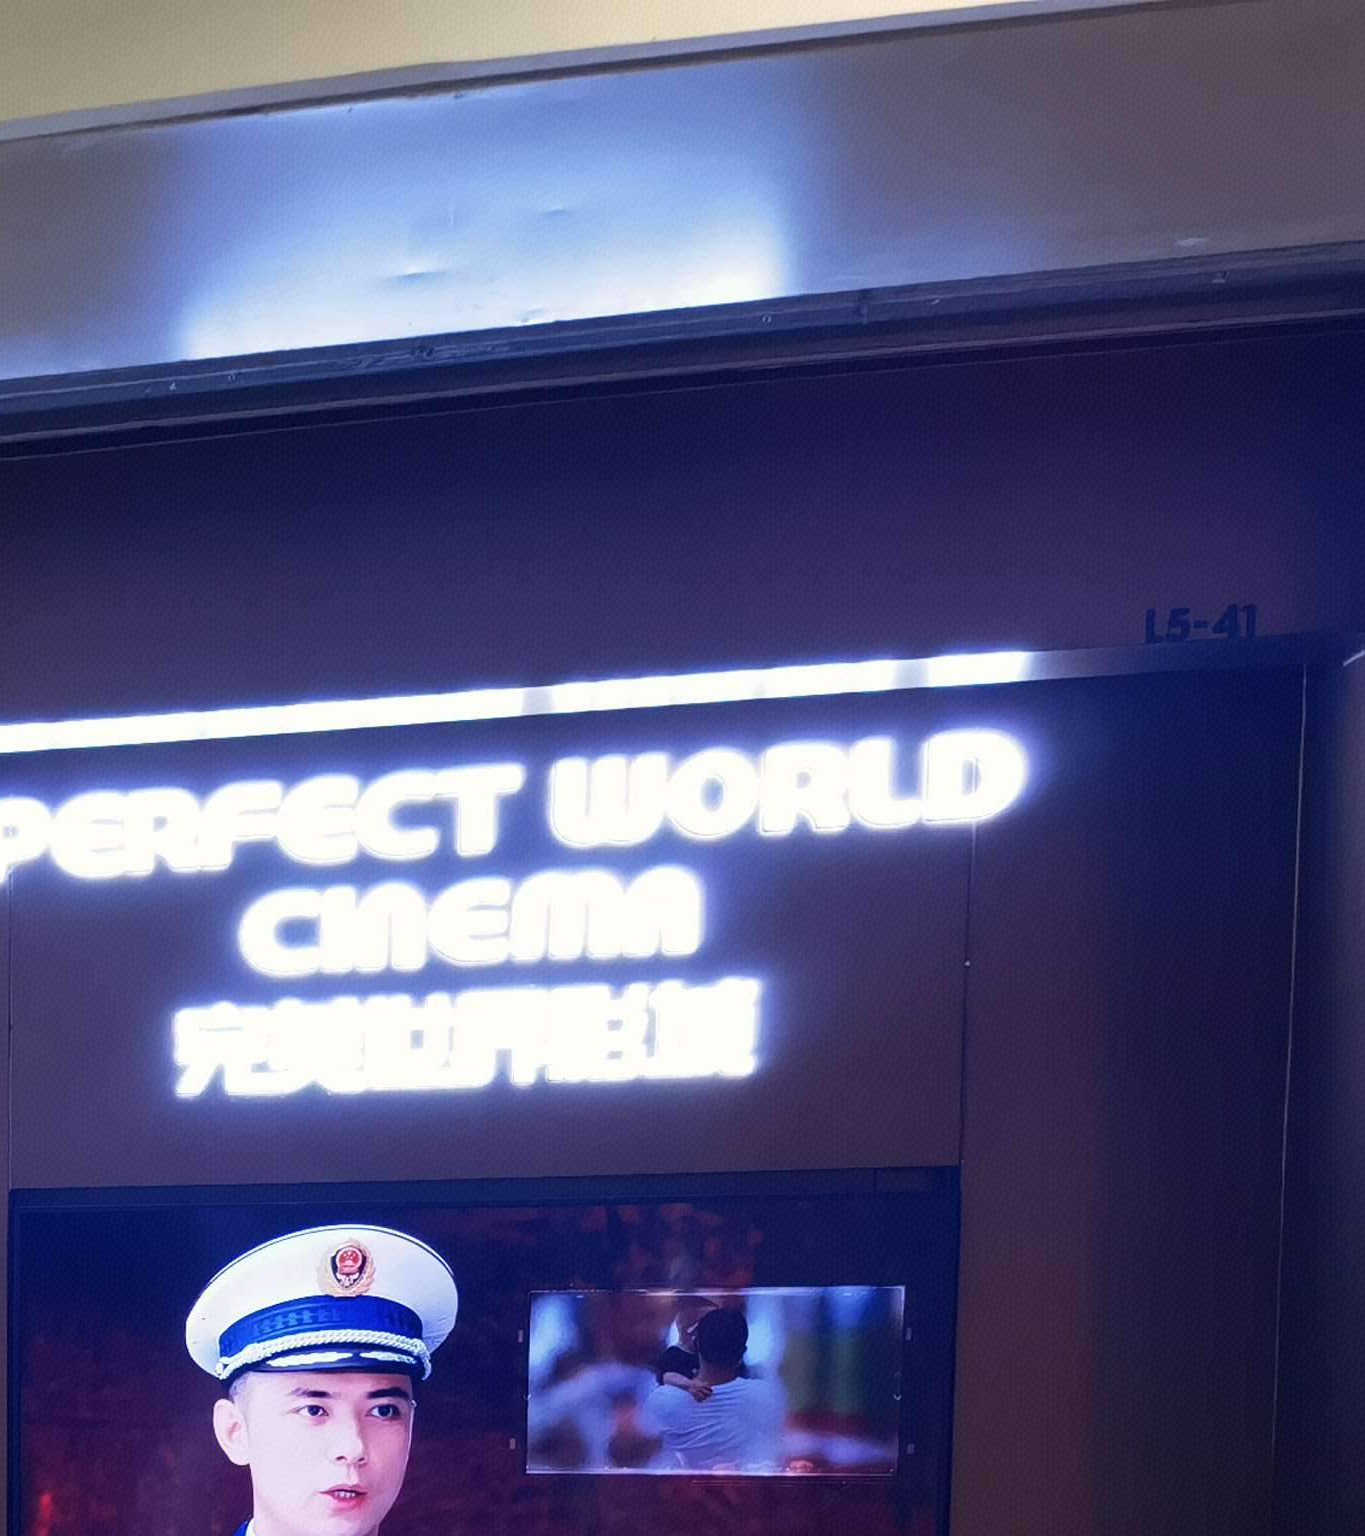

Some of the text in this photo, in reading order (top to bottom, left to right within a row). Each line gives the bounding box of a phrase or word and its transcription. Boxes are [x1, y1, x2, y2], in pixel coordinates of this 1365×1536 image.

[1145, 604, 1256, 644] L5-41
[548, 729, 1030, 846] WORLD
[237, 866, 706, 974] CINEMA
